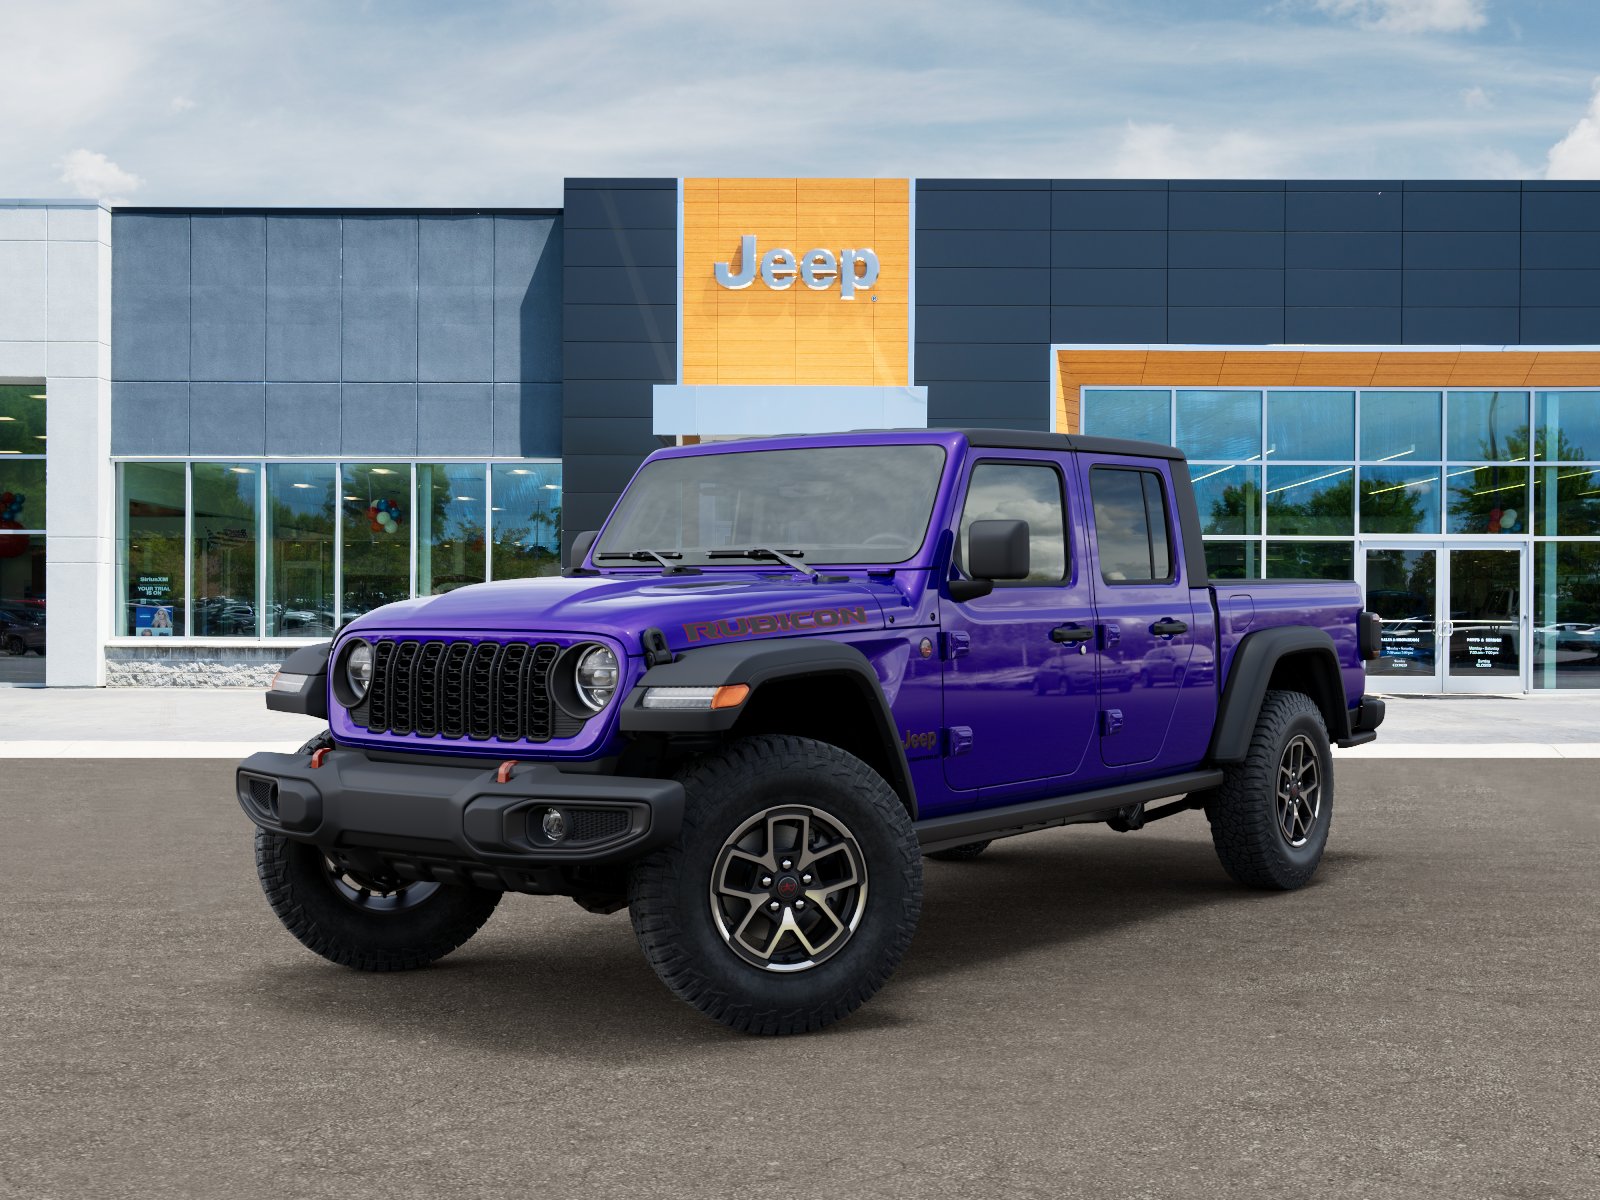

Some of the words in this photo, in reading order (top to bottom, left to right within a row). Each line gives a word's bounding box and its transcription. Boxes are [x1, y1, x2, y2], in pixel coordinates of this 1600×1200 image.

[714, 234, 881, 301] Jeep
[682, 606, 867, 643] RUBICON
[901, 729, 937, 750] Jeep
